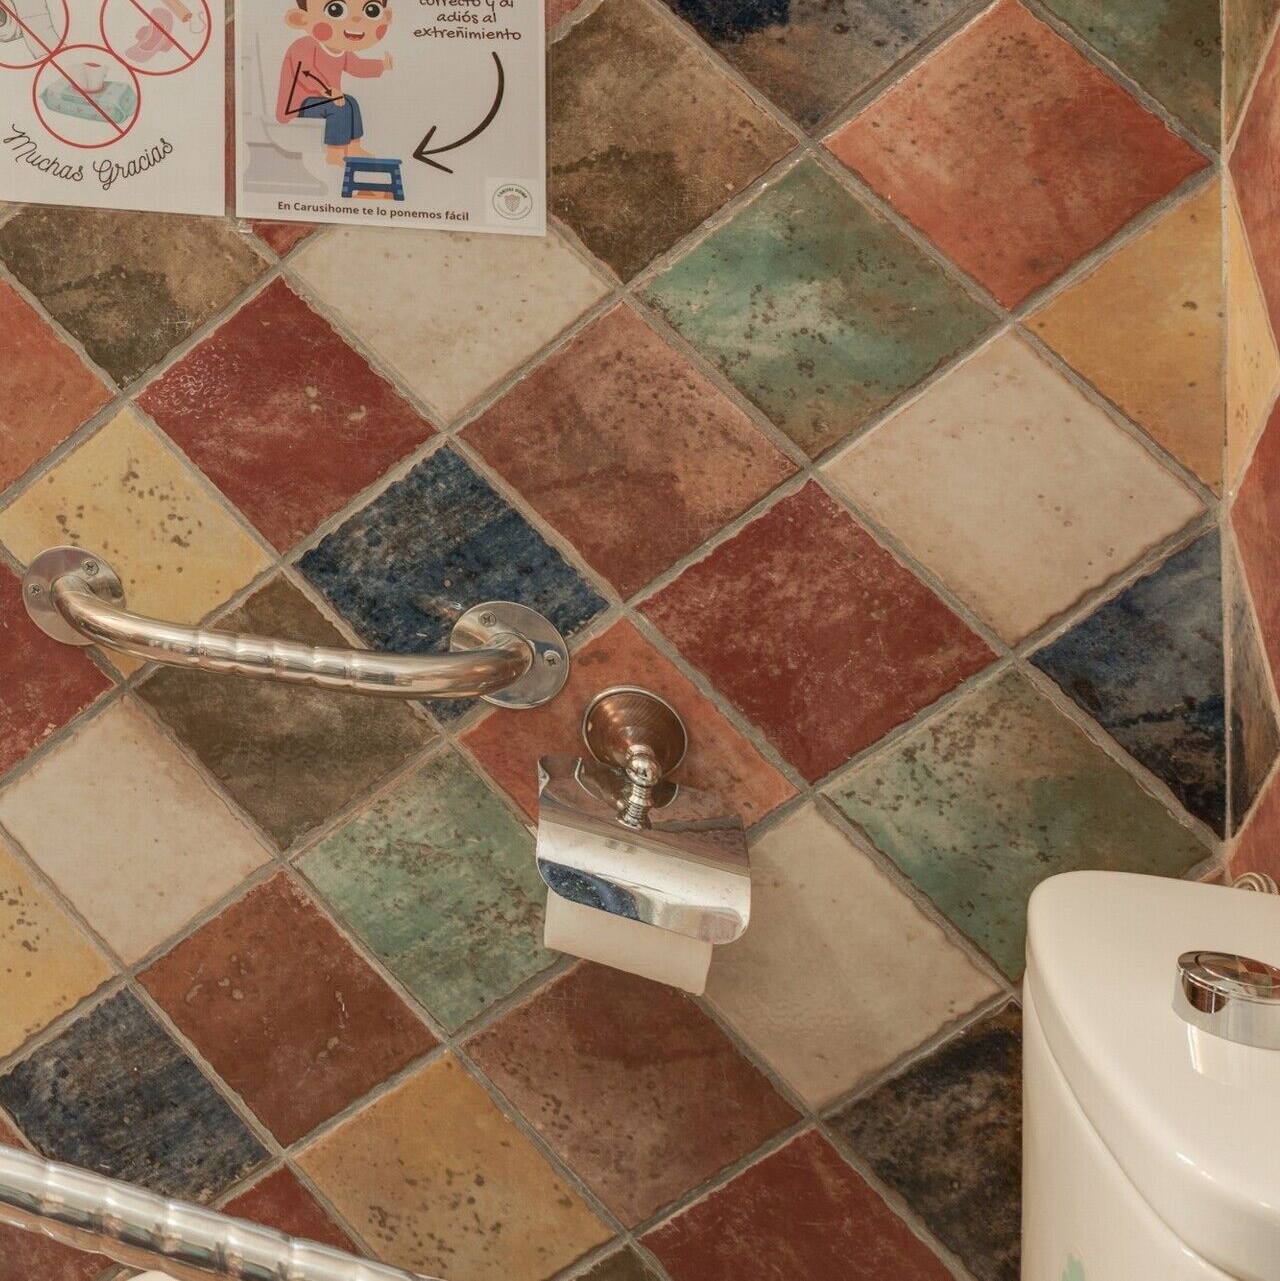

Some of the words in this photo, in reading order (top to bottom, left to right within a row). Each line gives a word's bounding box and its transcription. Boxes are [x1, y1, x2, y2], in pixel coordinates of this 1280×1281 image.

[437, 11, 479, 24] adiós
[483, 12, 496, 23] al
[414, 26, 522, 40] extreñimiento
[3, 123, 83, 182] Muchas
[93, 138, 173, 191] Gracias
[278, 202, 290, 211] En
[294, 203, 359, 215] Carusihome
[362, 207, 374, 216] te
[376, 207, 387, 216] lo
[390, 209, 441, 219] ponemos
[445, 211, 469, 221] fácil
